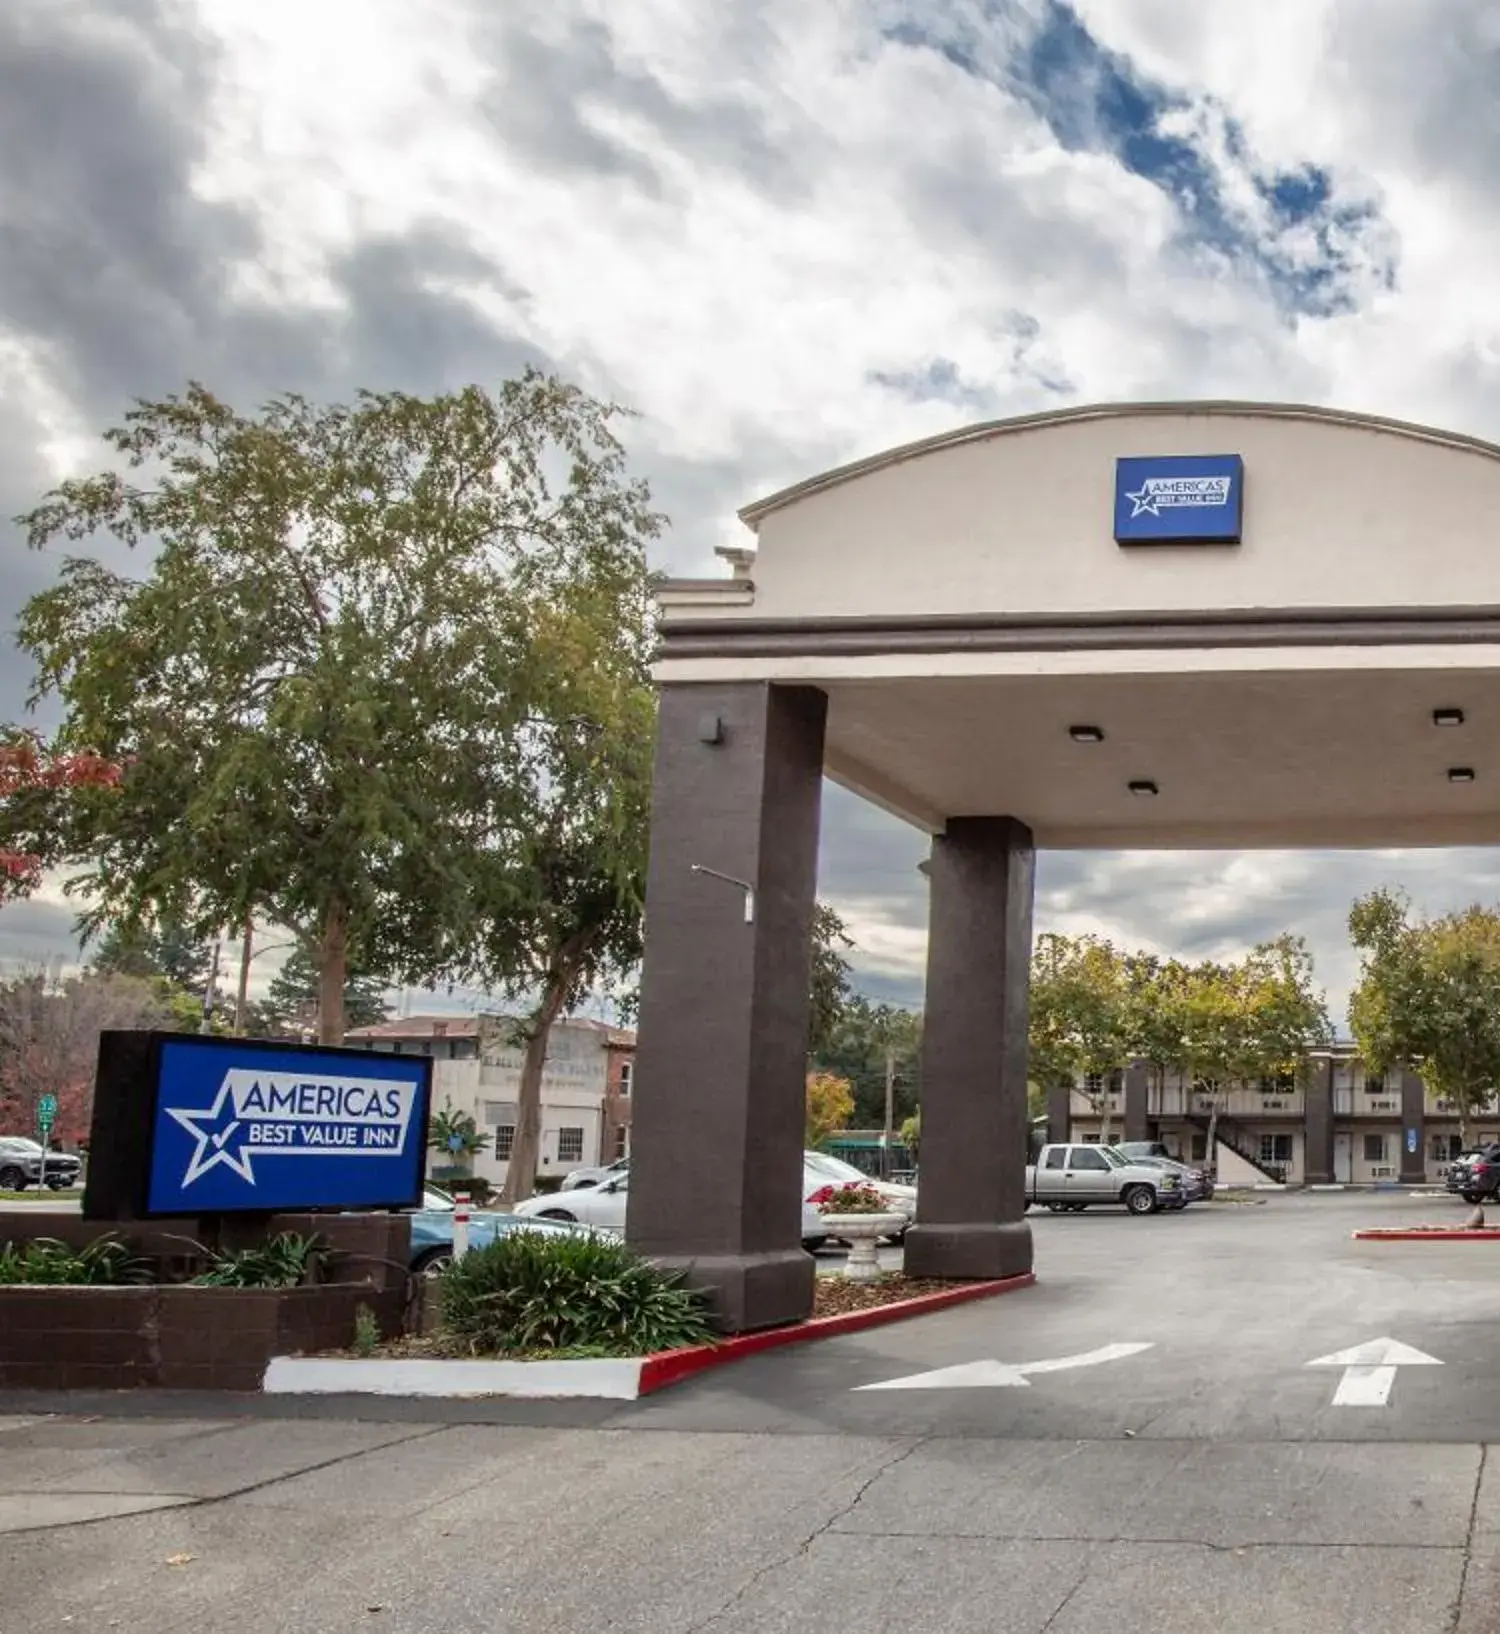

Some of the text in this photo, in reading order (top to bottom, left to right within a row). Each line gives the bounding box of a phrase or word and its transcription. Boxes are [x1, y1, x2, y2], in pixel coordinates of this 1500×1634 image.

[1152, 481, 1224, 492] AMERICAS
[240, 1080, 401, 1118] AMERICAS
[249, 1124, 395, 1145] BEST VALUE INN
